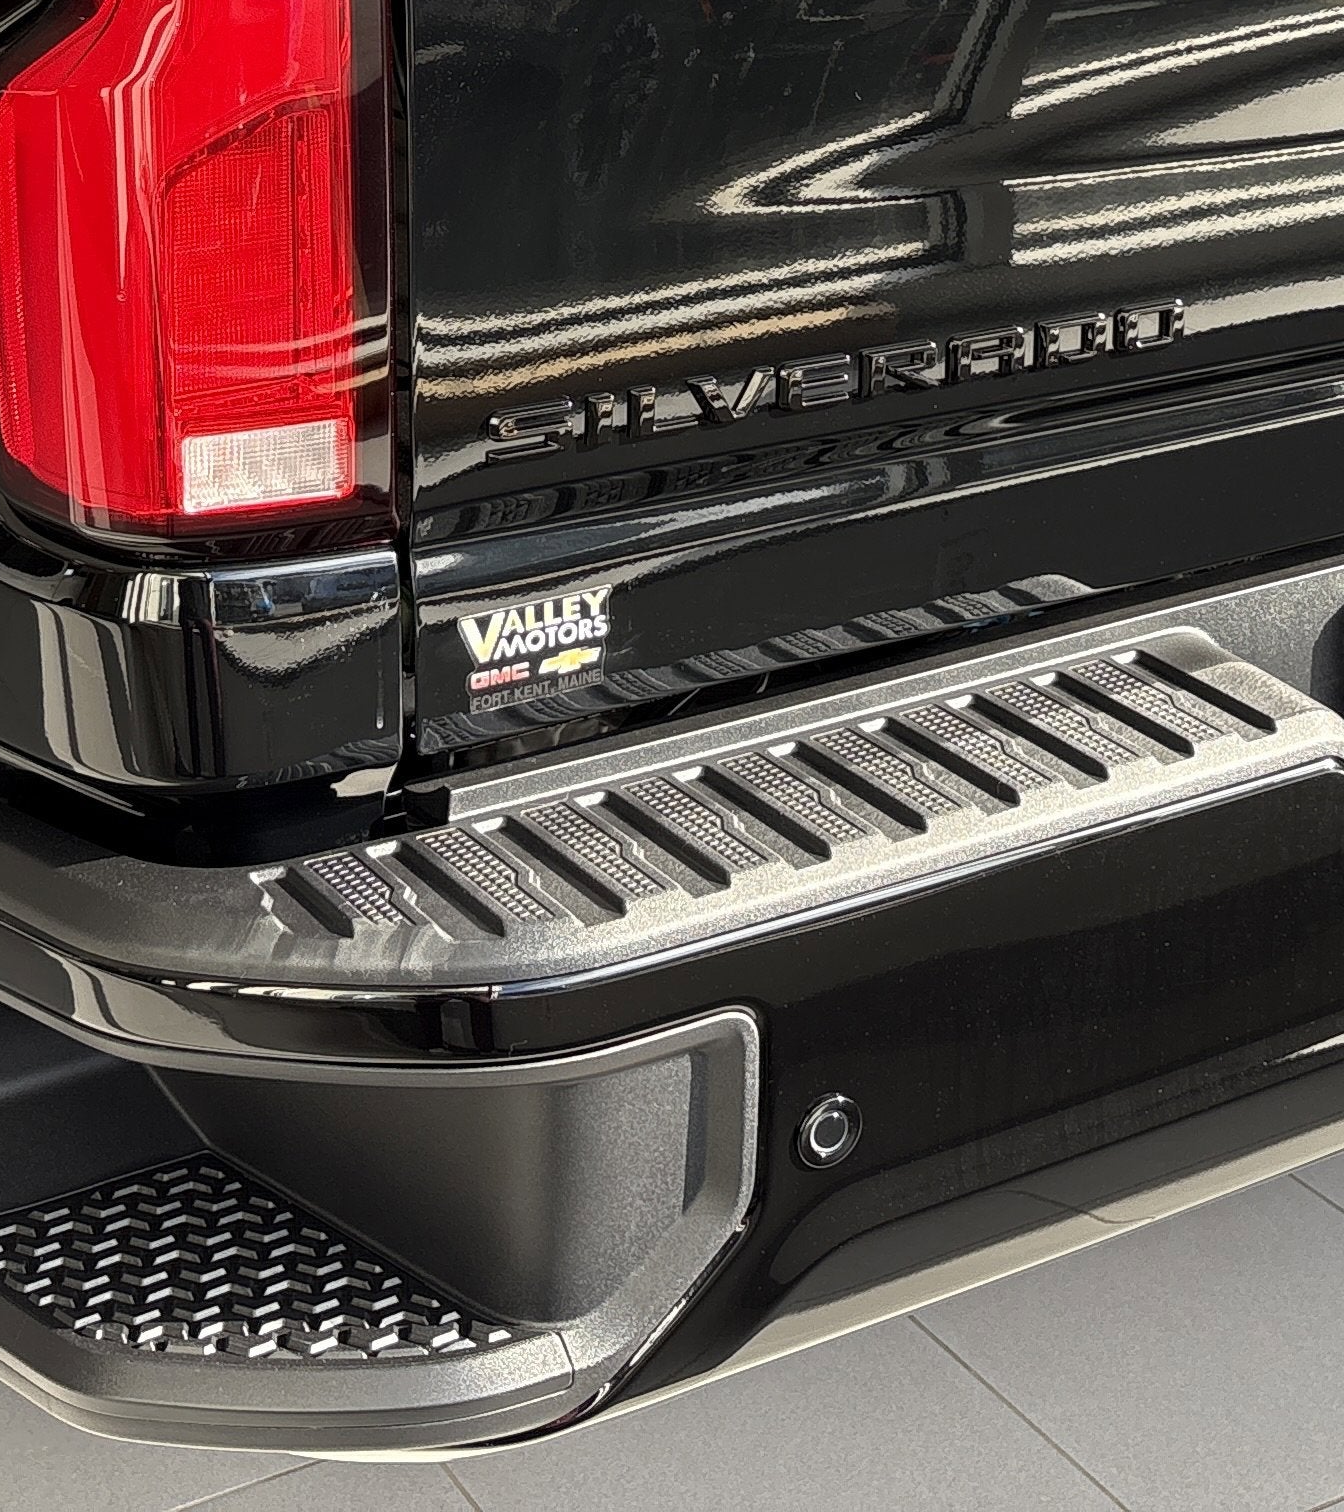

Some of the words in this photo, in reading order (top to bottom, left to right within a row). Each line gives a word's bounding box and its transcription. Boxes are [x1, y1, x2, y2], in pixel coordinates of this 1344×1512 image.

[484, 297, 1185, 465] SILVERADO
[460, 588, 609, 664] VALLEY
[492, 615, 608, 661] MOTORS
[470, 661, 530, 690] GMC
[472, 693, 510, 711] FORT
[558, 668, 602, 689] MAINE
